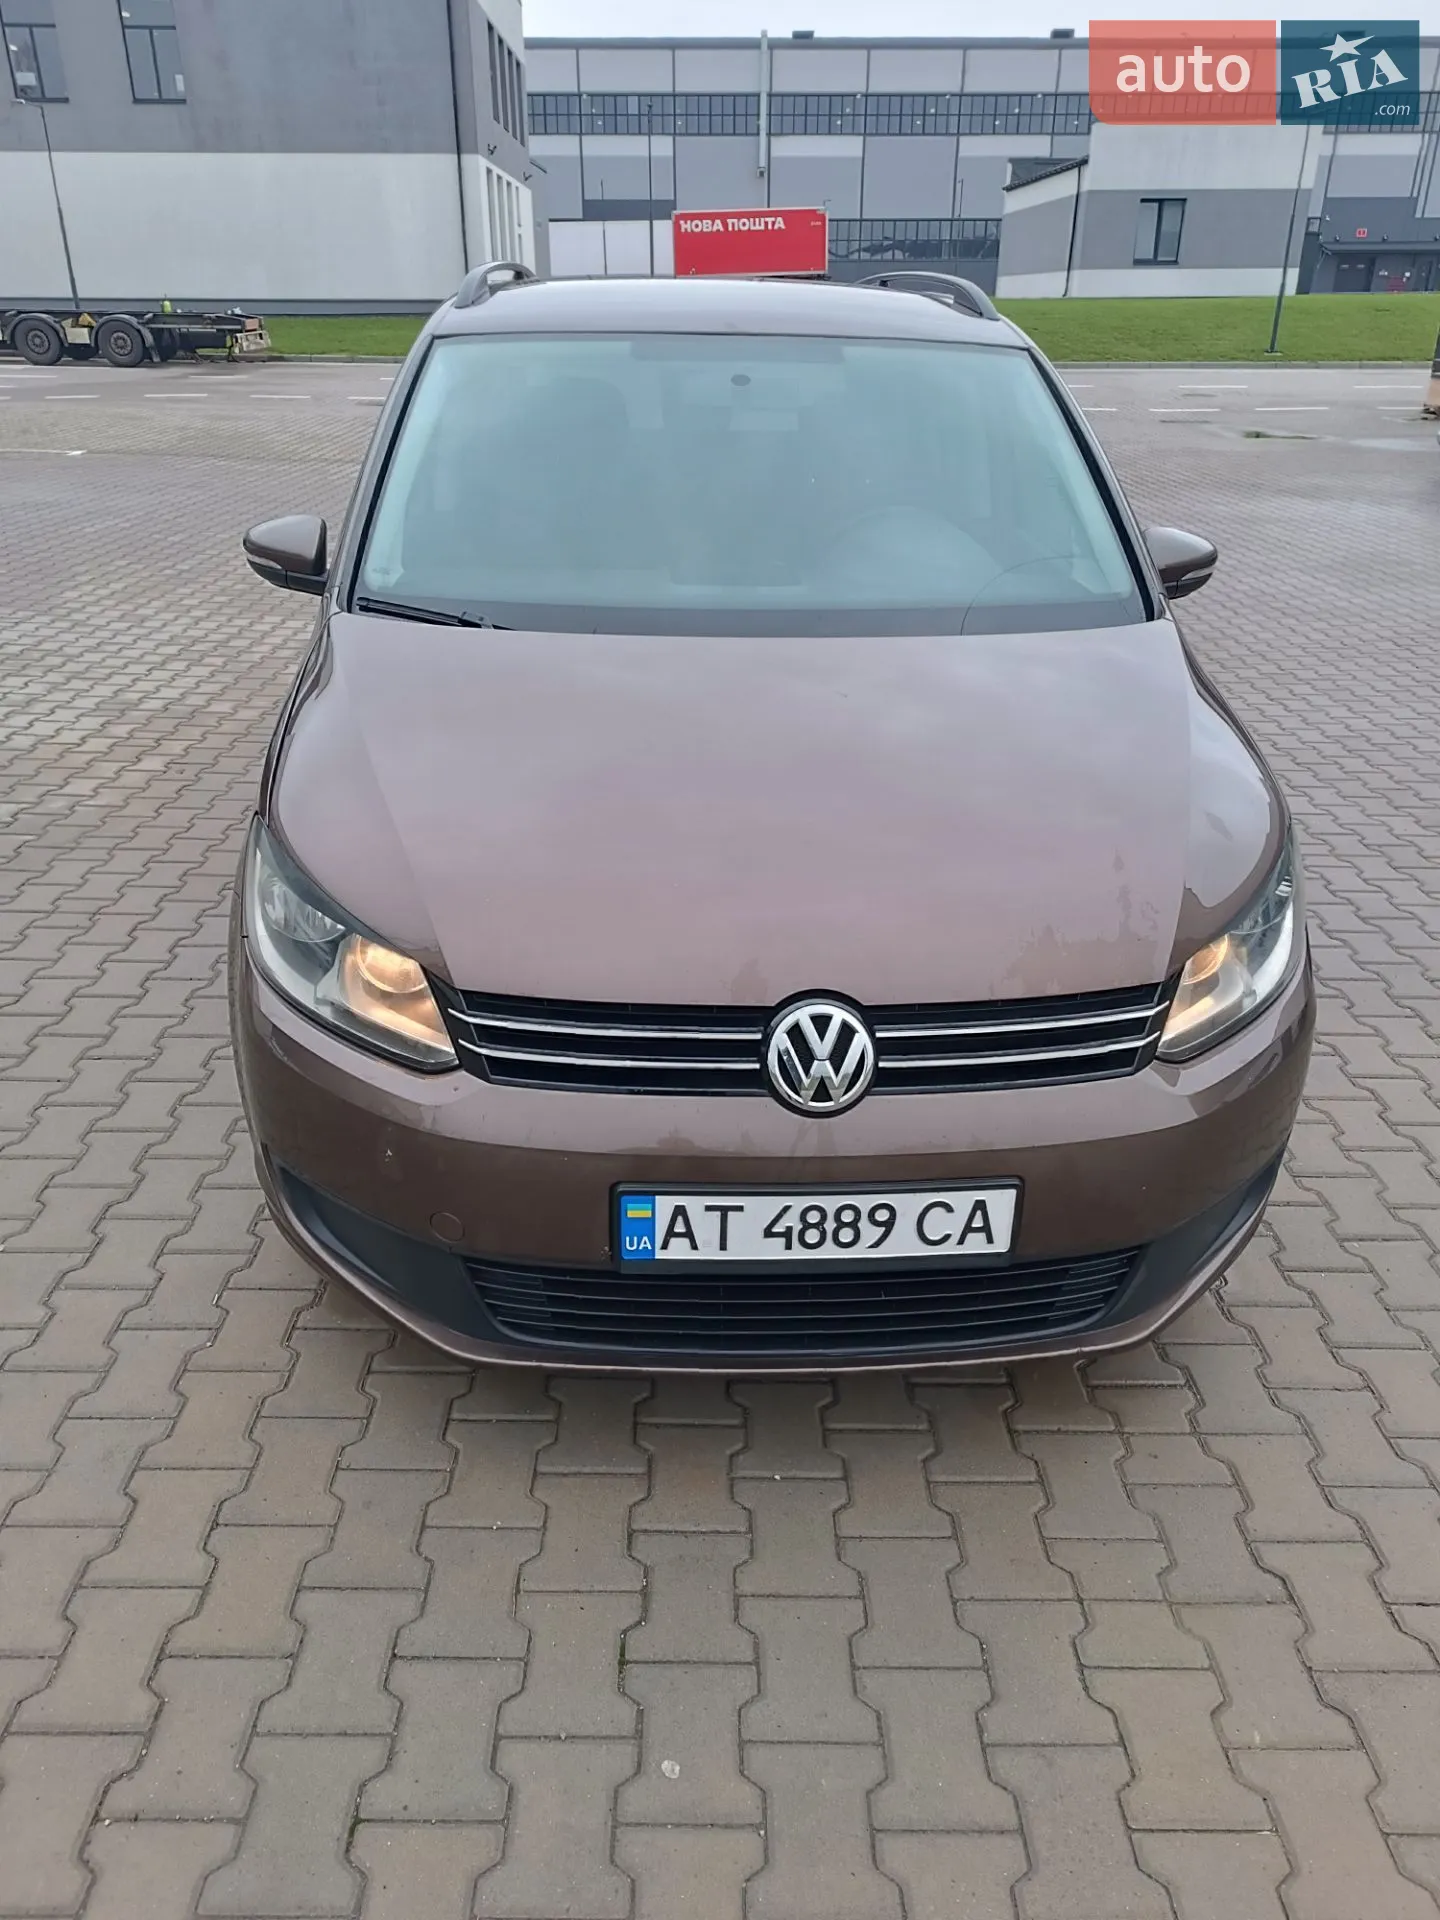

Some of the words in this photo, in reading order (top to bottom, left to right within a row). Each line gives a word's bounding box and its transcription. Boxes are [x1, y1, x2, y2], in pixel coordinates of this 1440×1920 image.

[680, 219, 724, 233] НОВА
[727, 217, 785, 231] ПОШТА
[660, 1204, 744, 1251] AT
[763, 1203, 897, 1251] 4889
[916, 1199, 995, 1246] CA
[626, 1237, 652, 1251] UA
